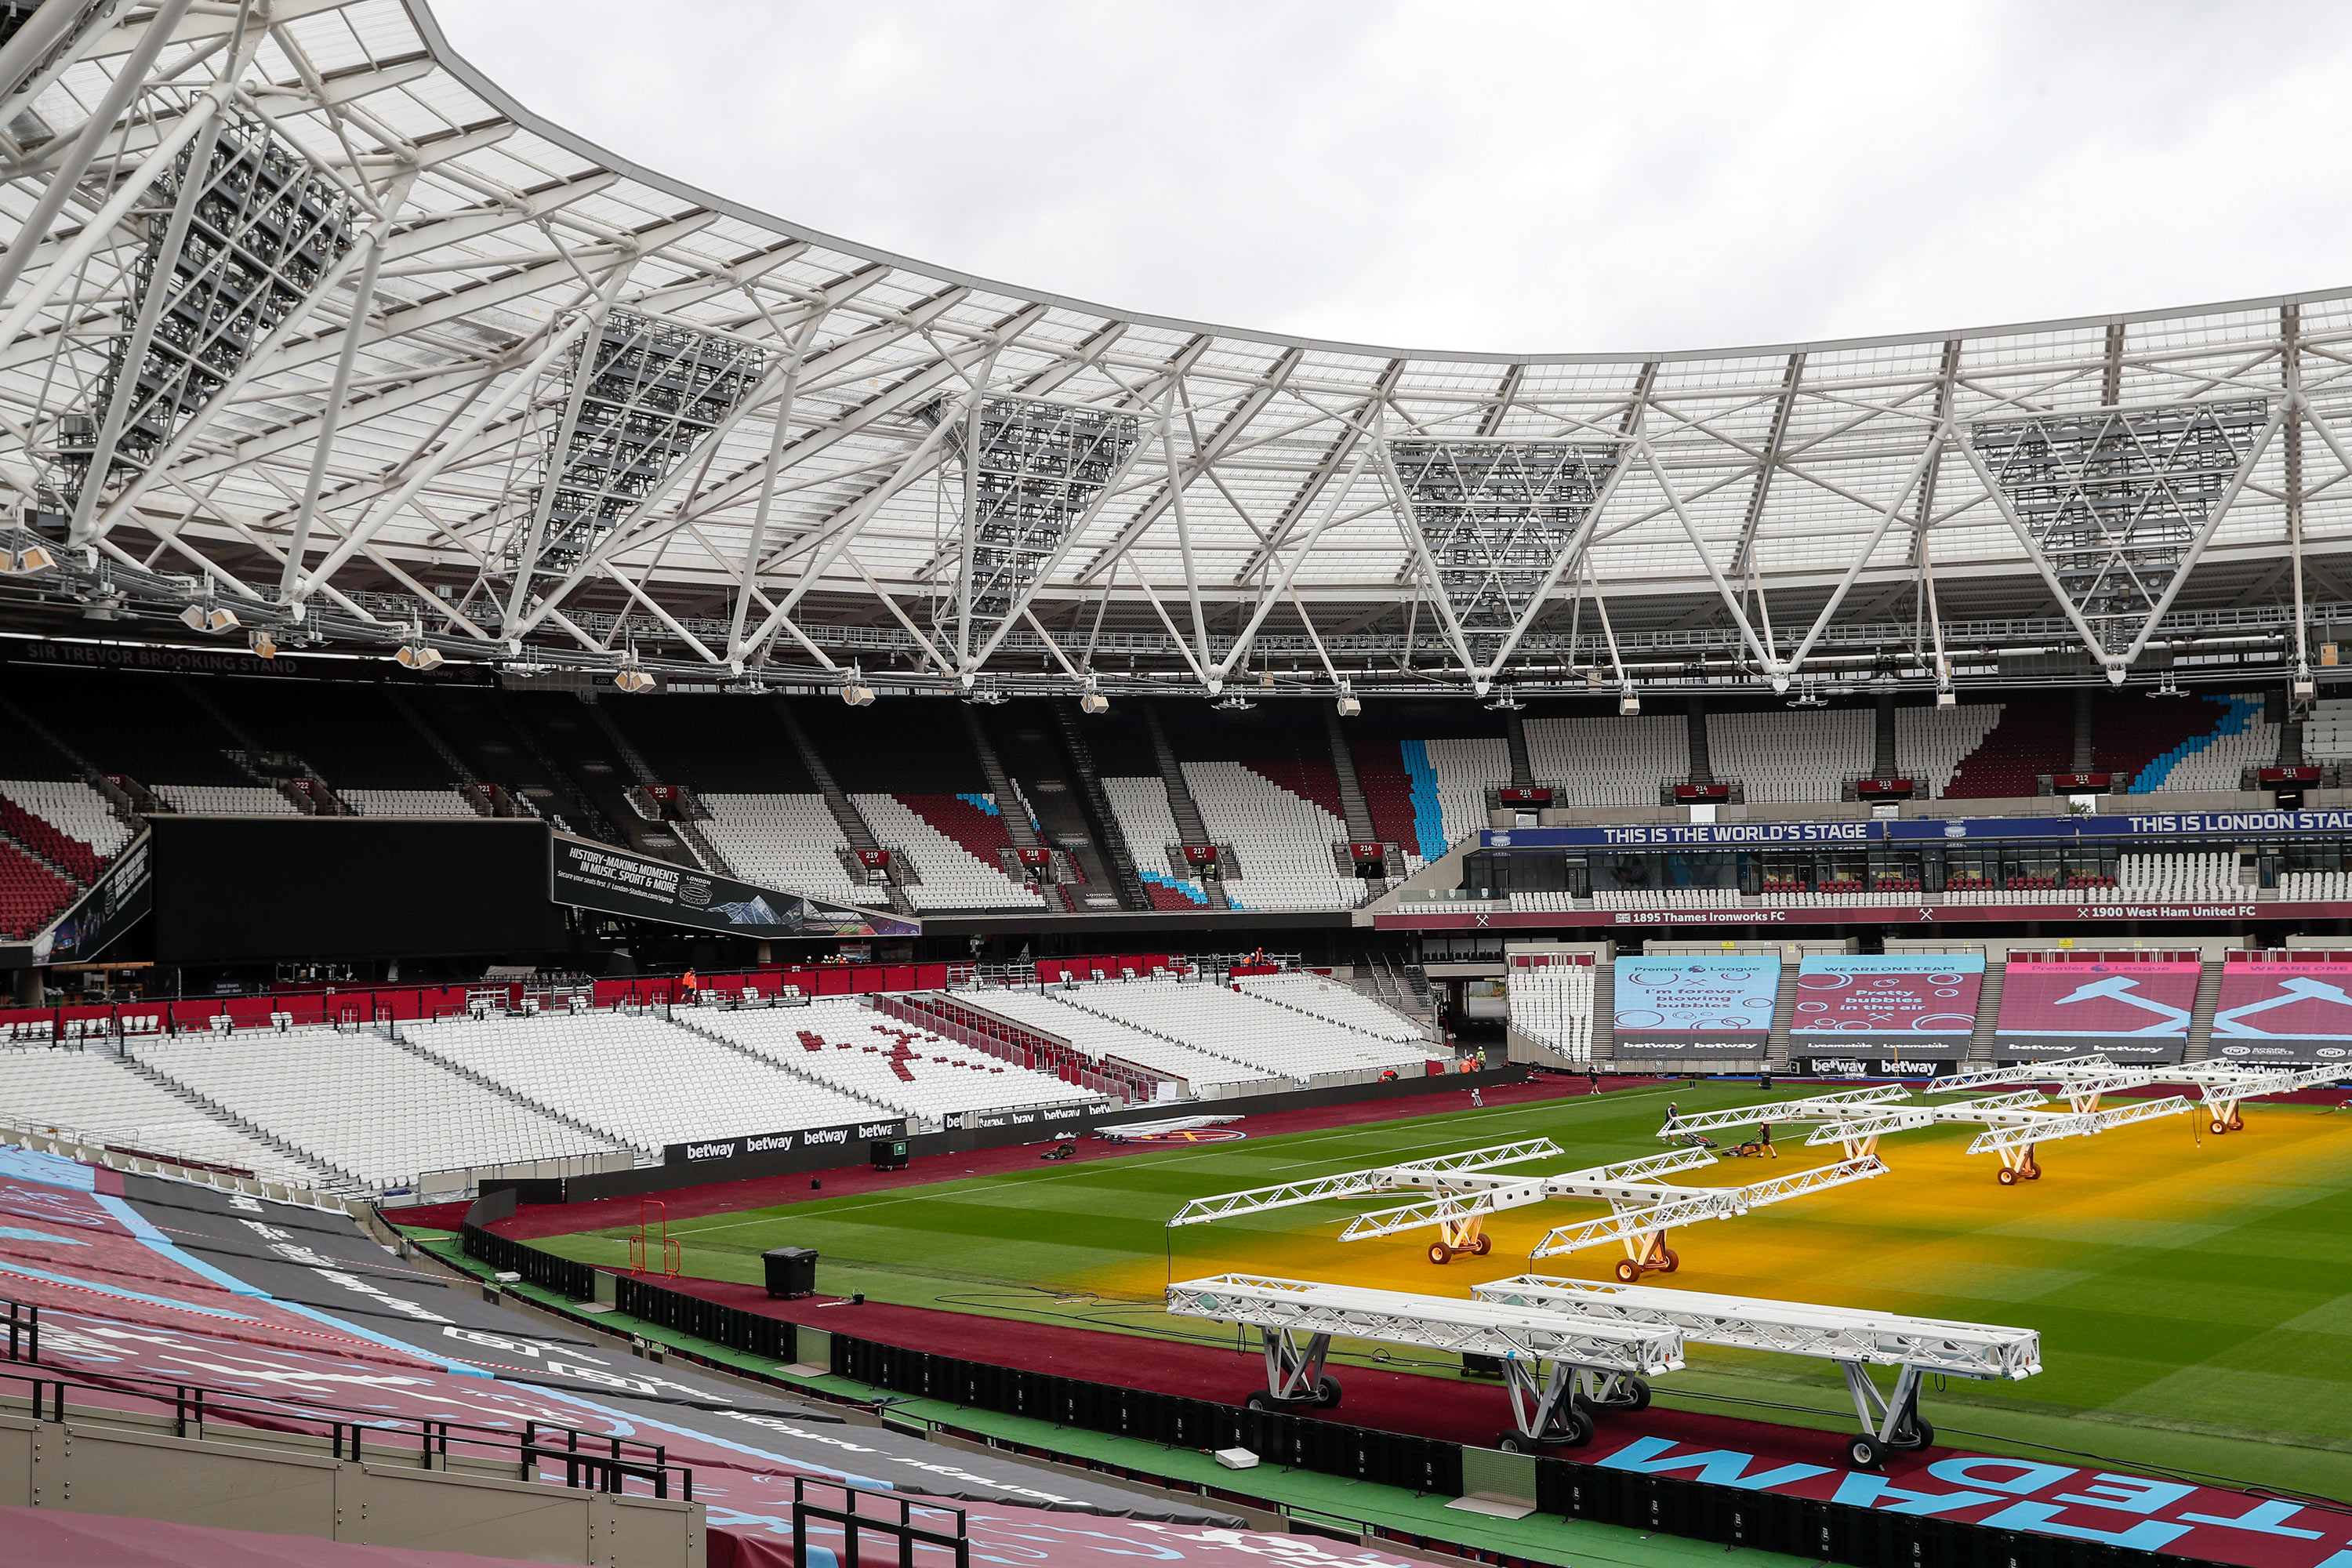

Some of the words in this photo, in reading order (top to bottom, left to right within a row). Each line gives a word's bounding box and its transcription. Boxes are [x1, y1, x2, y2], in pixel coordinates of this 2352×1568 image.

[27, 644, 56, 659] SIR
[63, 645, 135, 664] TREVOR
[140, 649, 235, 670] BROOKING
[239, 655, 298, 673] STAND
[2129, 816, 2176, 833] THIS
[2181, 815, 2200, 832] IS
[2205, 814, 2296, 831] LONDON
[1603, 828, 1647, 844] THIS
[1650, 827, 1668, 843] IS
[1671, 826, 1709, 842] THE
[1713, 825, 1801, 841] WORLD'S
[1804, 823, 1867, 840] STAGE
[568, 847, 639, 873] HISTORY-MAKING
[637, 863, 681, 884] MOMENTS
[557, 869, 574, 881] Secure
[572, 873, 584, 884] your
[583, 876, 597, 886] seats
[579, 861, 590, 873] IN
[589, 863, 617, 881] MUSIC,
[618, 870, 644, 886] SPORT
[645, 877, 653, 887] &
[652, 879, 677, 894] MORE
[686, 875, 712, 886] LONDON
[1633, 913, 1661, 923] 1895
[1663, 913, 1707, 923] Thames
[1709, 912, 1768, 922] Ironworks
[1770, 911, 1786, 921] FC
[2092, 907, 2124, 917] 1900
[2125, 906, 2158, 917] West
[2160, 906, 2190, 917] Ham
[2192, 906, 2236, 916] United
[2238, 906, 2256, 916] FC
[2009, 1044, 2078, 1052] betway
[2093, 1045, 2164, 1054] betway
[1882, 1059, 1937, 1076] betway
[746, 1136, 793, 1152] betway
[804, 1130, 848, 1145] betway
[687, 1143, 735, 1159] betway
